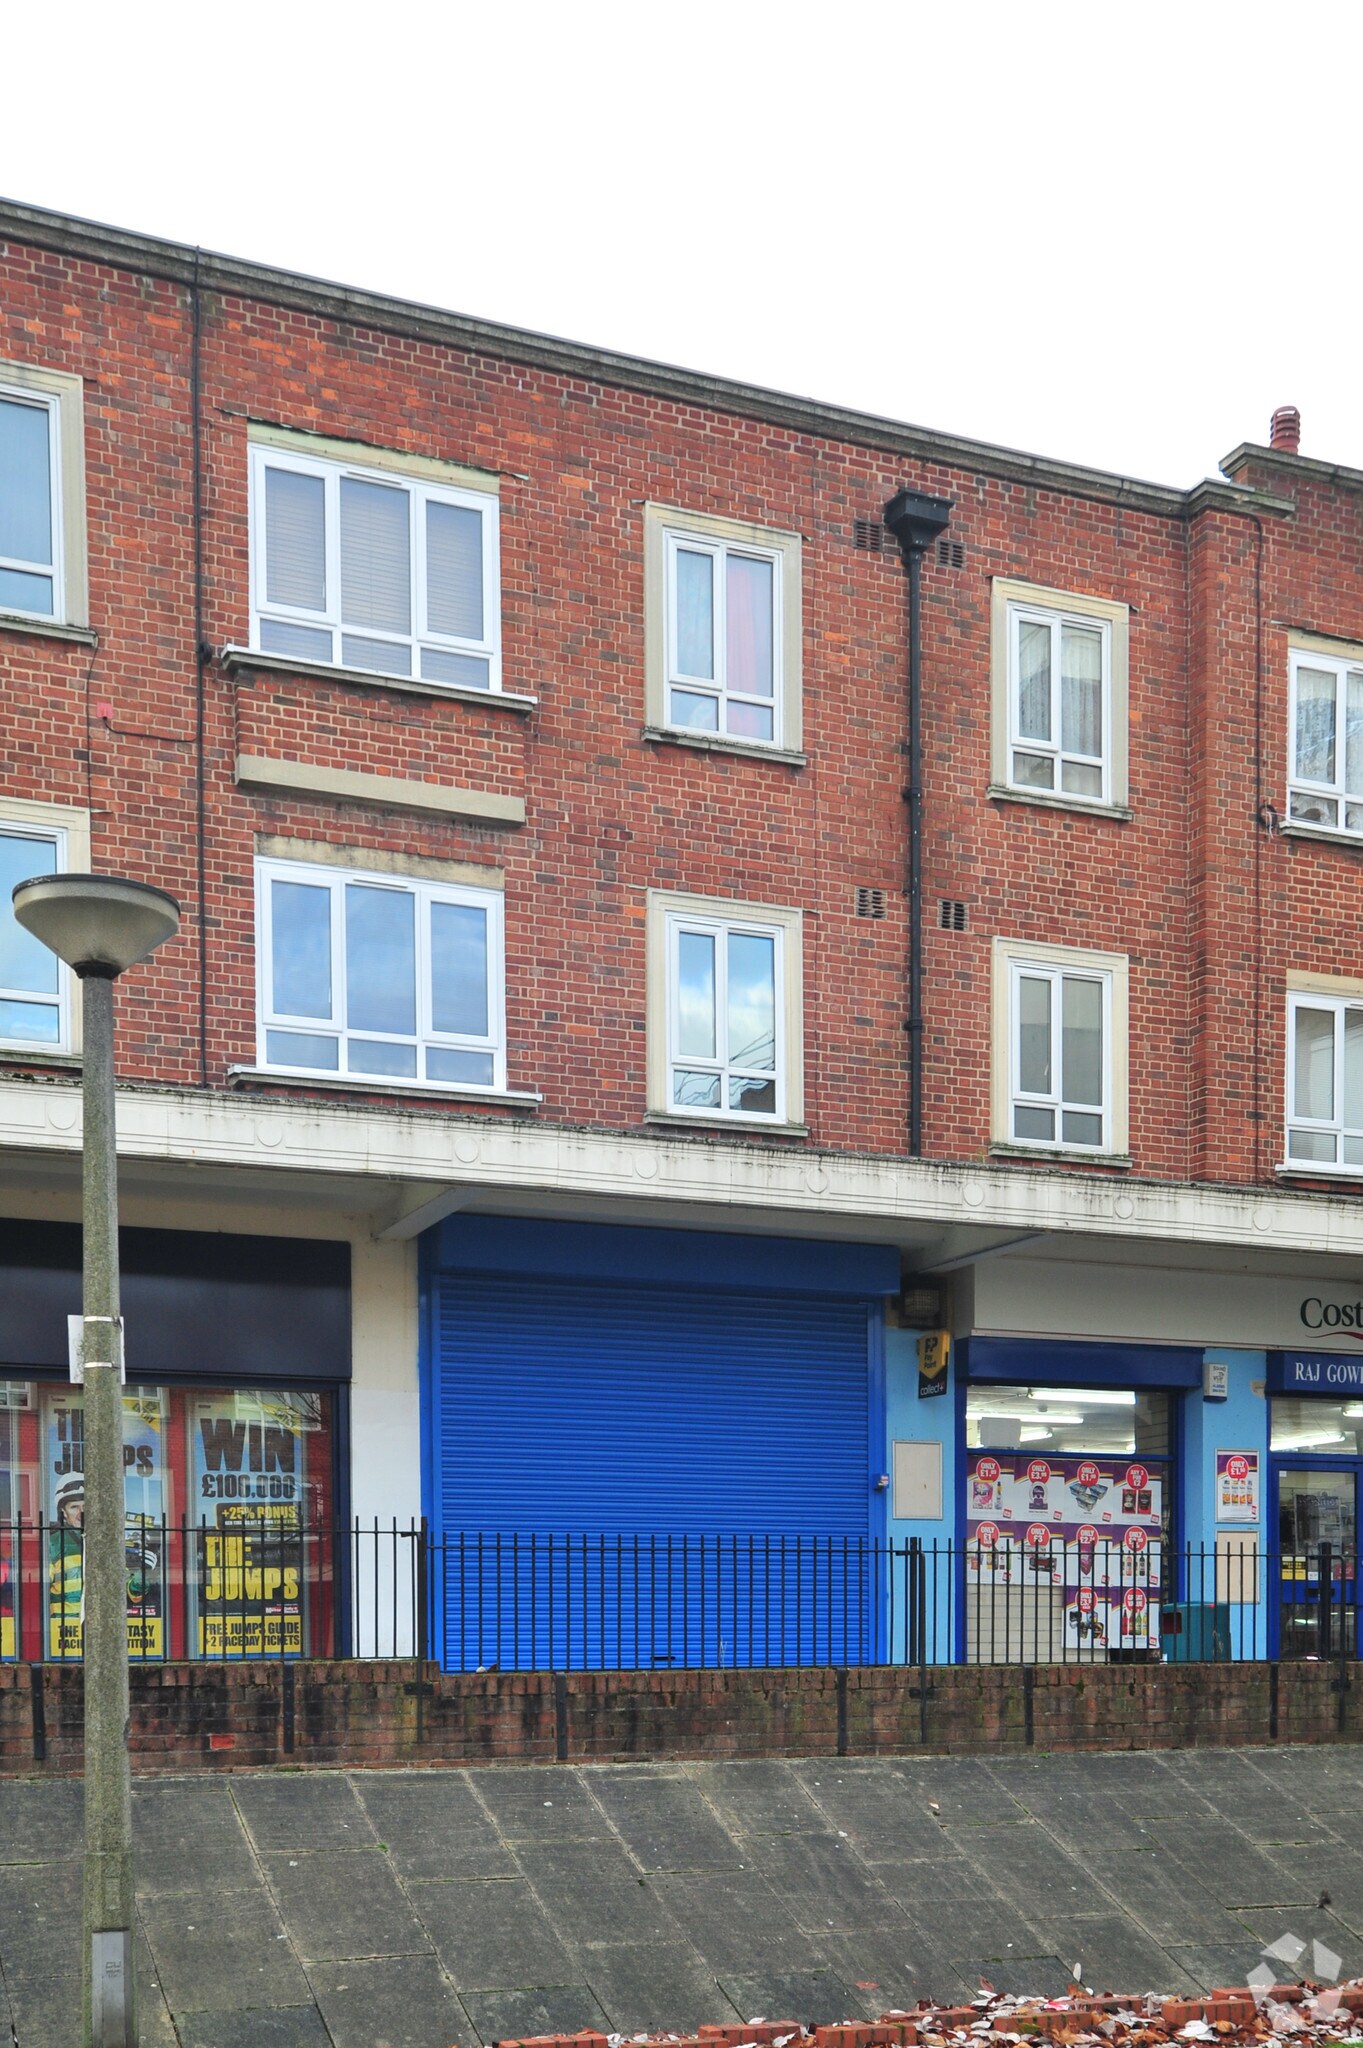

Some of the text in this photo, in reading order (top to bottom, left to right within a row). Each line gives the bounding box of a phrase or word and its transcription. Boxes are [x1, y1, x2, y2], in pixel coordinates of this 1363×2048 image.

[1295, 1362, 1320, 1381] RAJ
[200, 1418, 295, 1473] WIN
[54, 1443, 153, 1477] JUPS
[202, 1474, 295, 1498] £100,000
[257, 1506, 296, 1519] BONUS
[206, 1536, 252, 1566] THE
[206, 1568, 298, 1600] JUMPS
[127, 1625, 154, 1637] TASY
